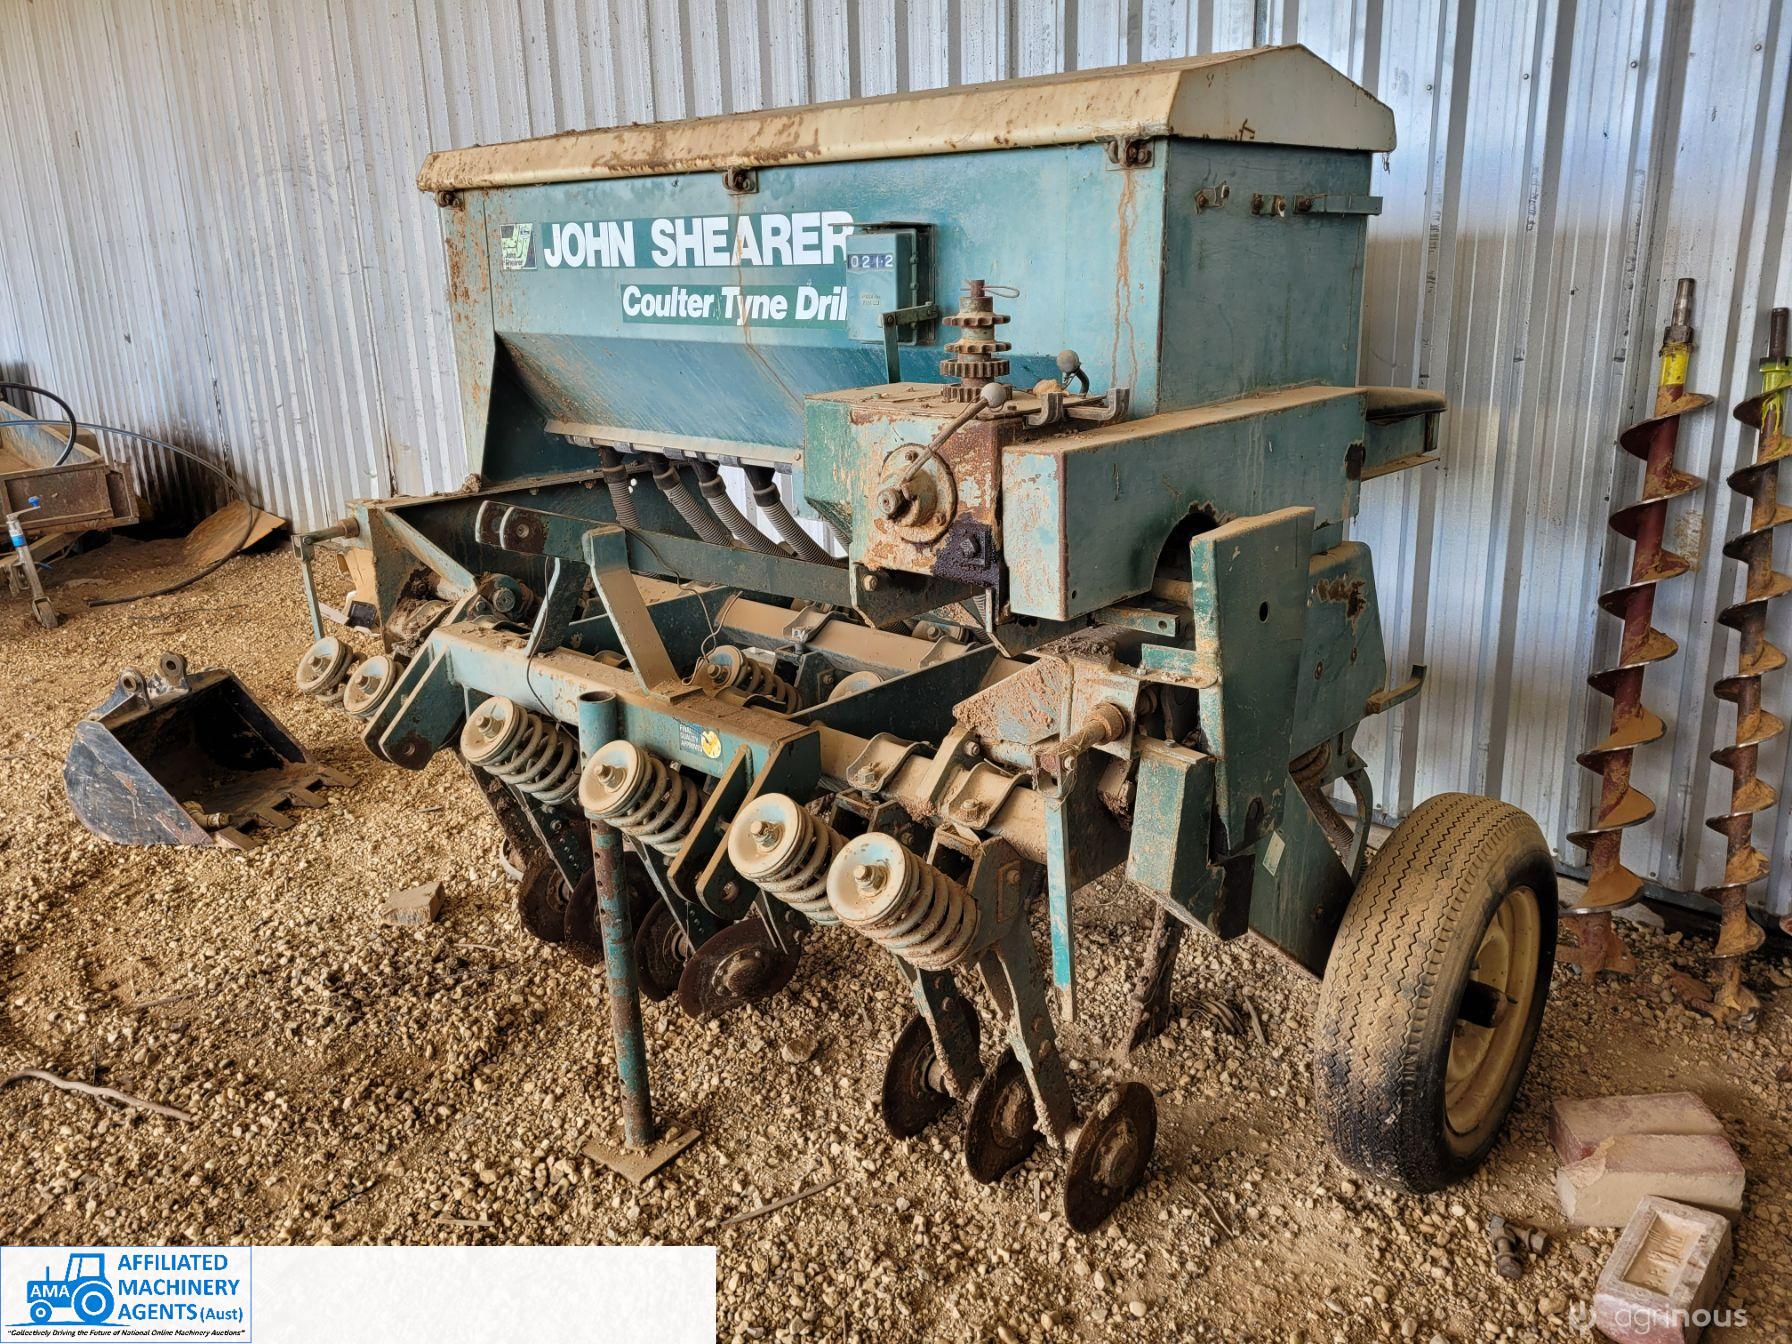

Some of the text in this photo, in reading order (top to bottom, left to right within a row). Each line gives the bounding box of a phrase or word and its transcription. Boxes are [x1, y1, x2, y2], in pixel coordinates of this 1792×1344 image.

[544, 211, 854, 268] JOHN SHEARER
[622, 285, 848, 326] Coulter Tyne Dril
